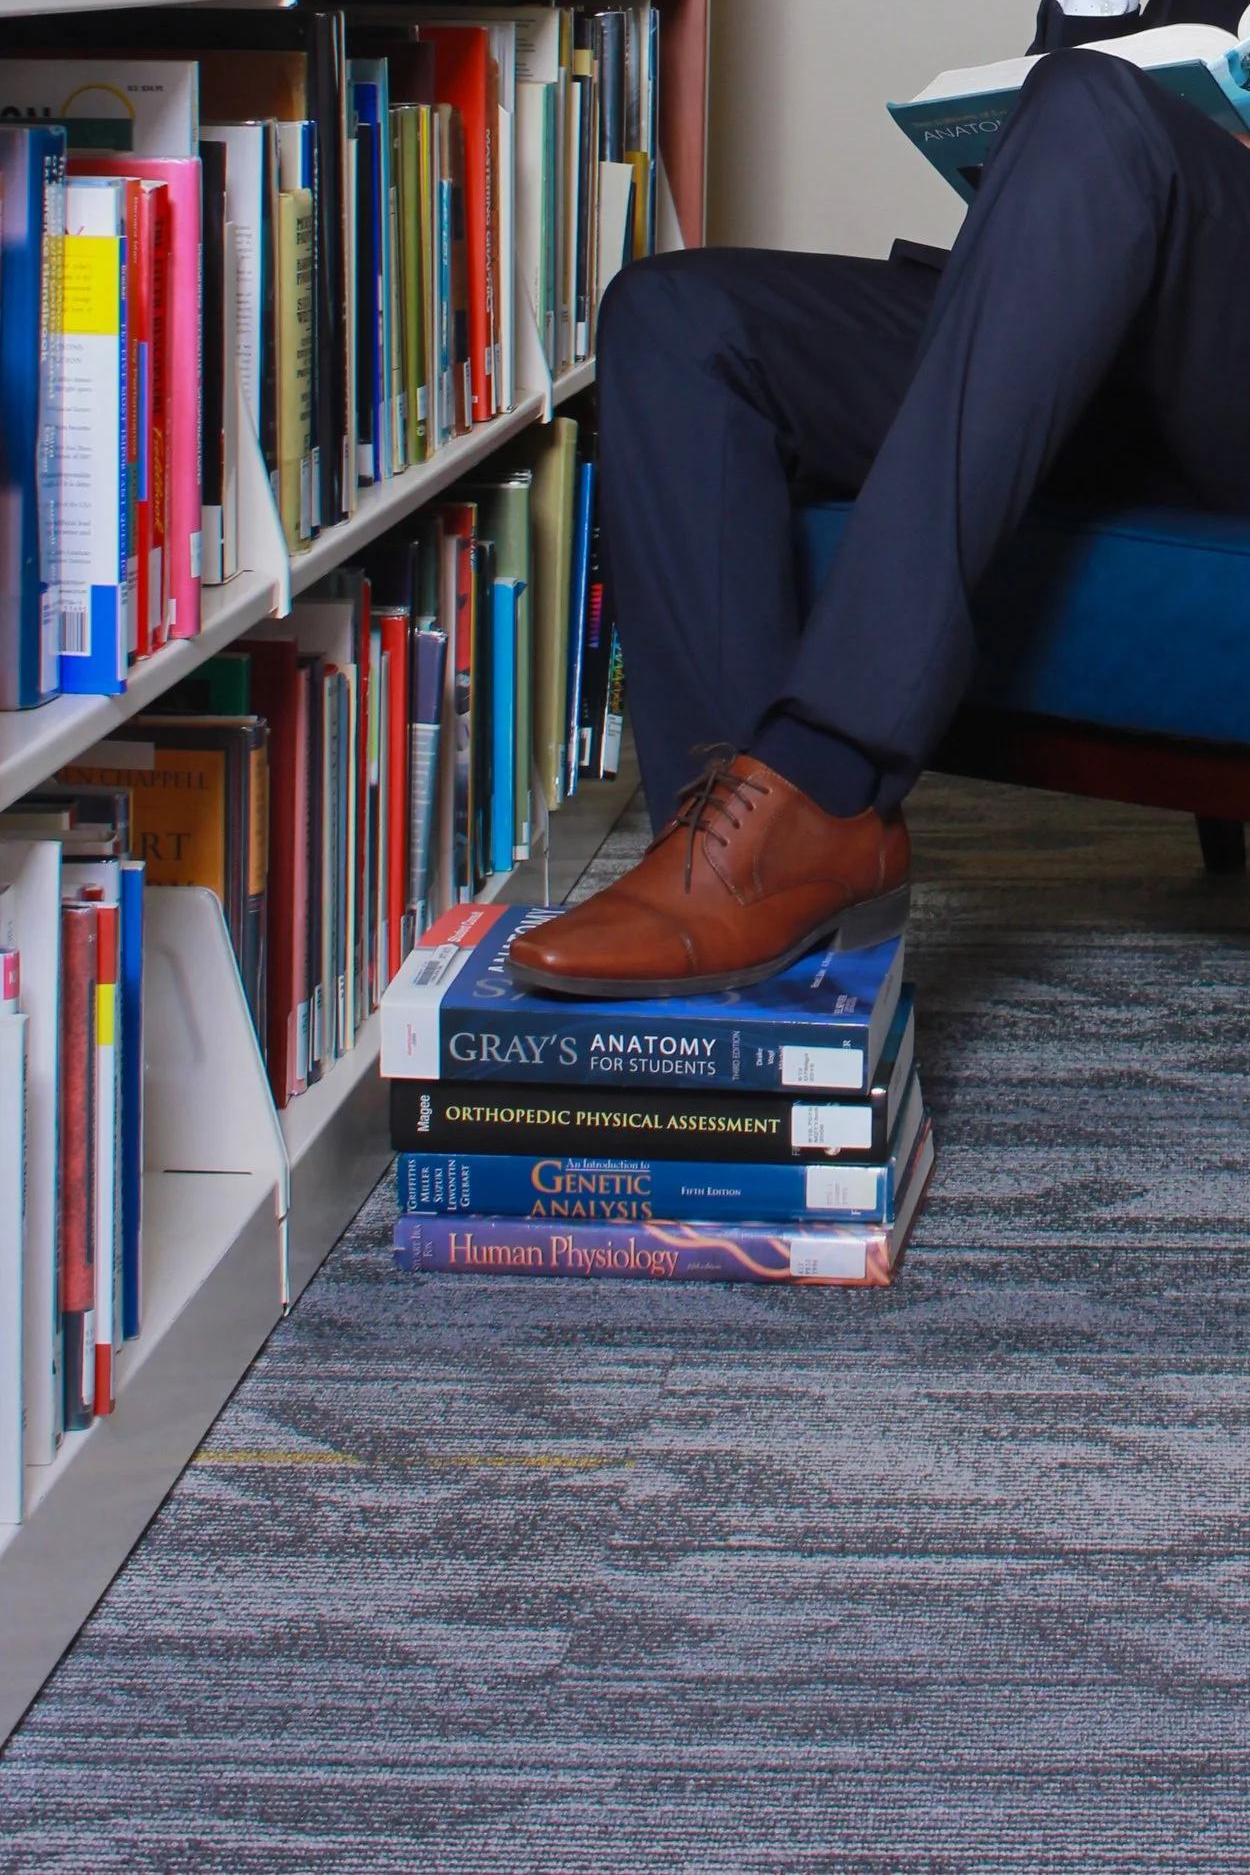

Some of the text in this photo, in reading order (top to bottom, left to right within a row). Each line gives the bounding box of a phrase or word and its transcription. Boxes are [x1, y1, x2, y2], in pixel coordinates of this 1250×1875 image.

[41, 262, 49, 362] Handbook
[152, 257, 164, 535] FIFTH Fieldbook
[100, 769, 209, 790] CHAPPELL
[449, 1031, 577, 1065] GRAY'S
[590, 1033, 717, 1058] ANATOMY
[731, 1030, 741, 1081] THIRD EDITION
[755, 1047, 763, 1067] Drake
[590, 1055, 717, 1075] FOR STUDENTS
[416, 1094, 433, 1133] Magee
[445, 1106, 781, 1135] ORTHOPEDIC PHYSICAL ASSESSMENT
[531, 1159, 652, 1195] GENETIC
[565, 1158, 650, 1170] An Introduction to
[681, 1186, 742, 1198] FIFTH EDITION
[531, 1200, 653, 1219] ANALYSIS
[448, 1232, 680, 1275] Human Physiology
